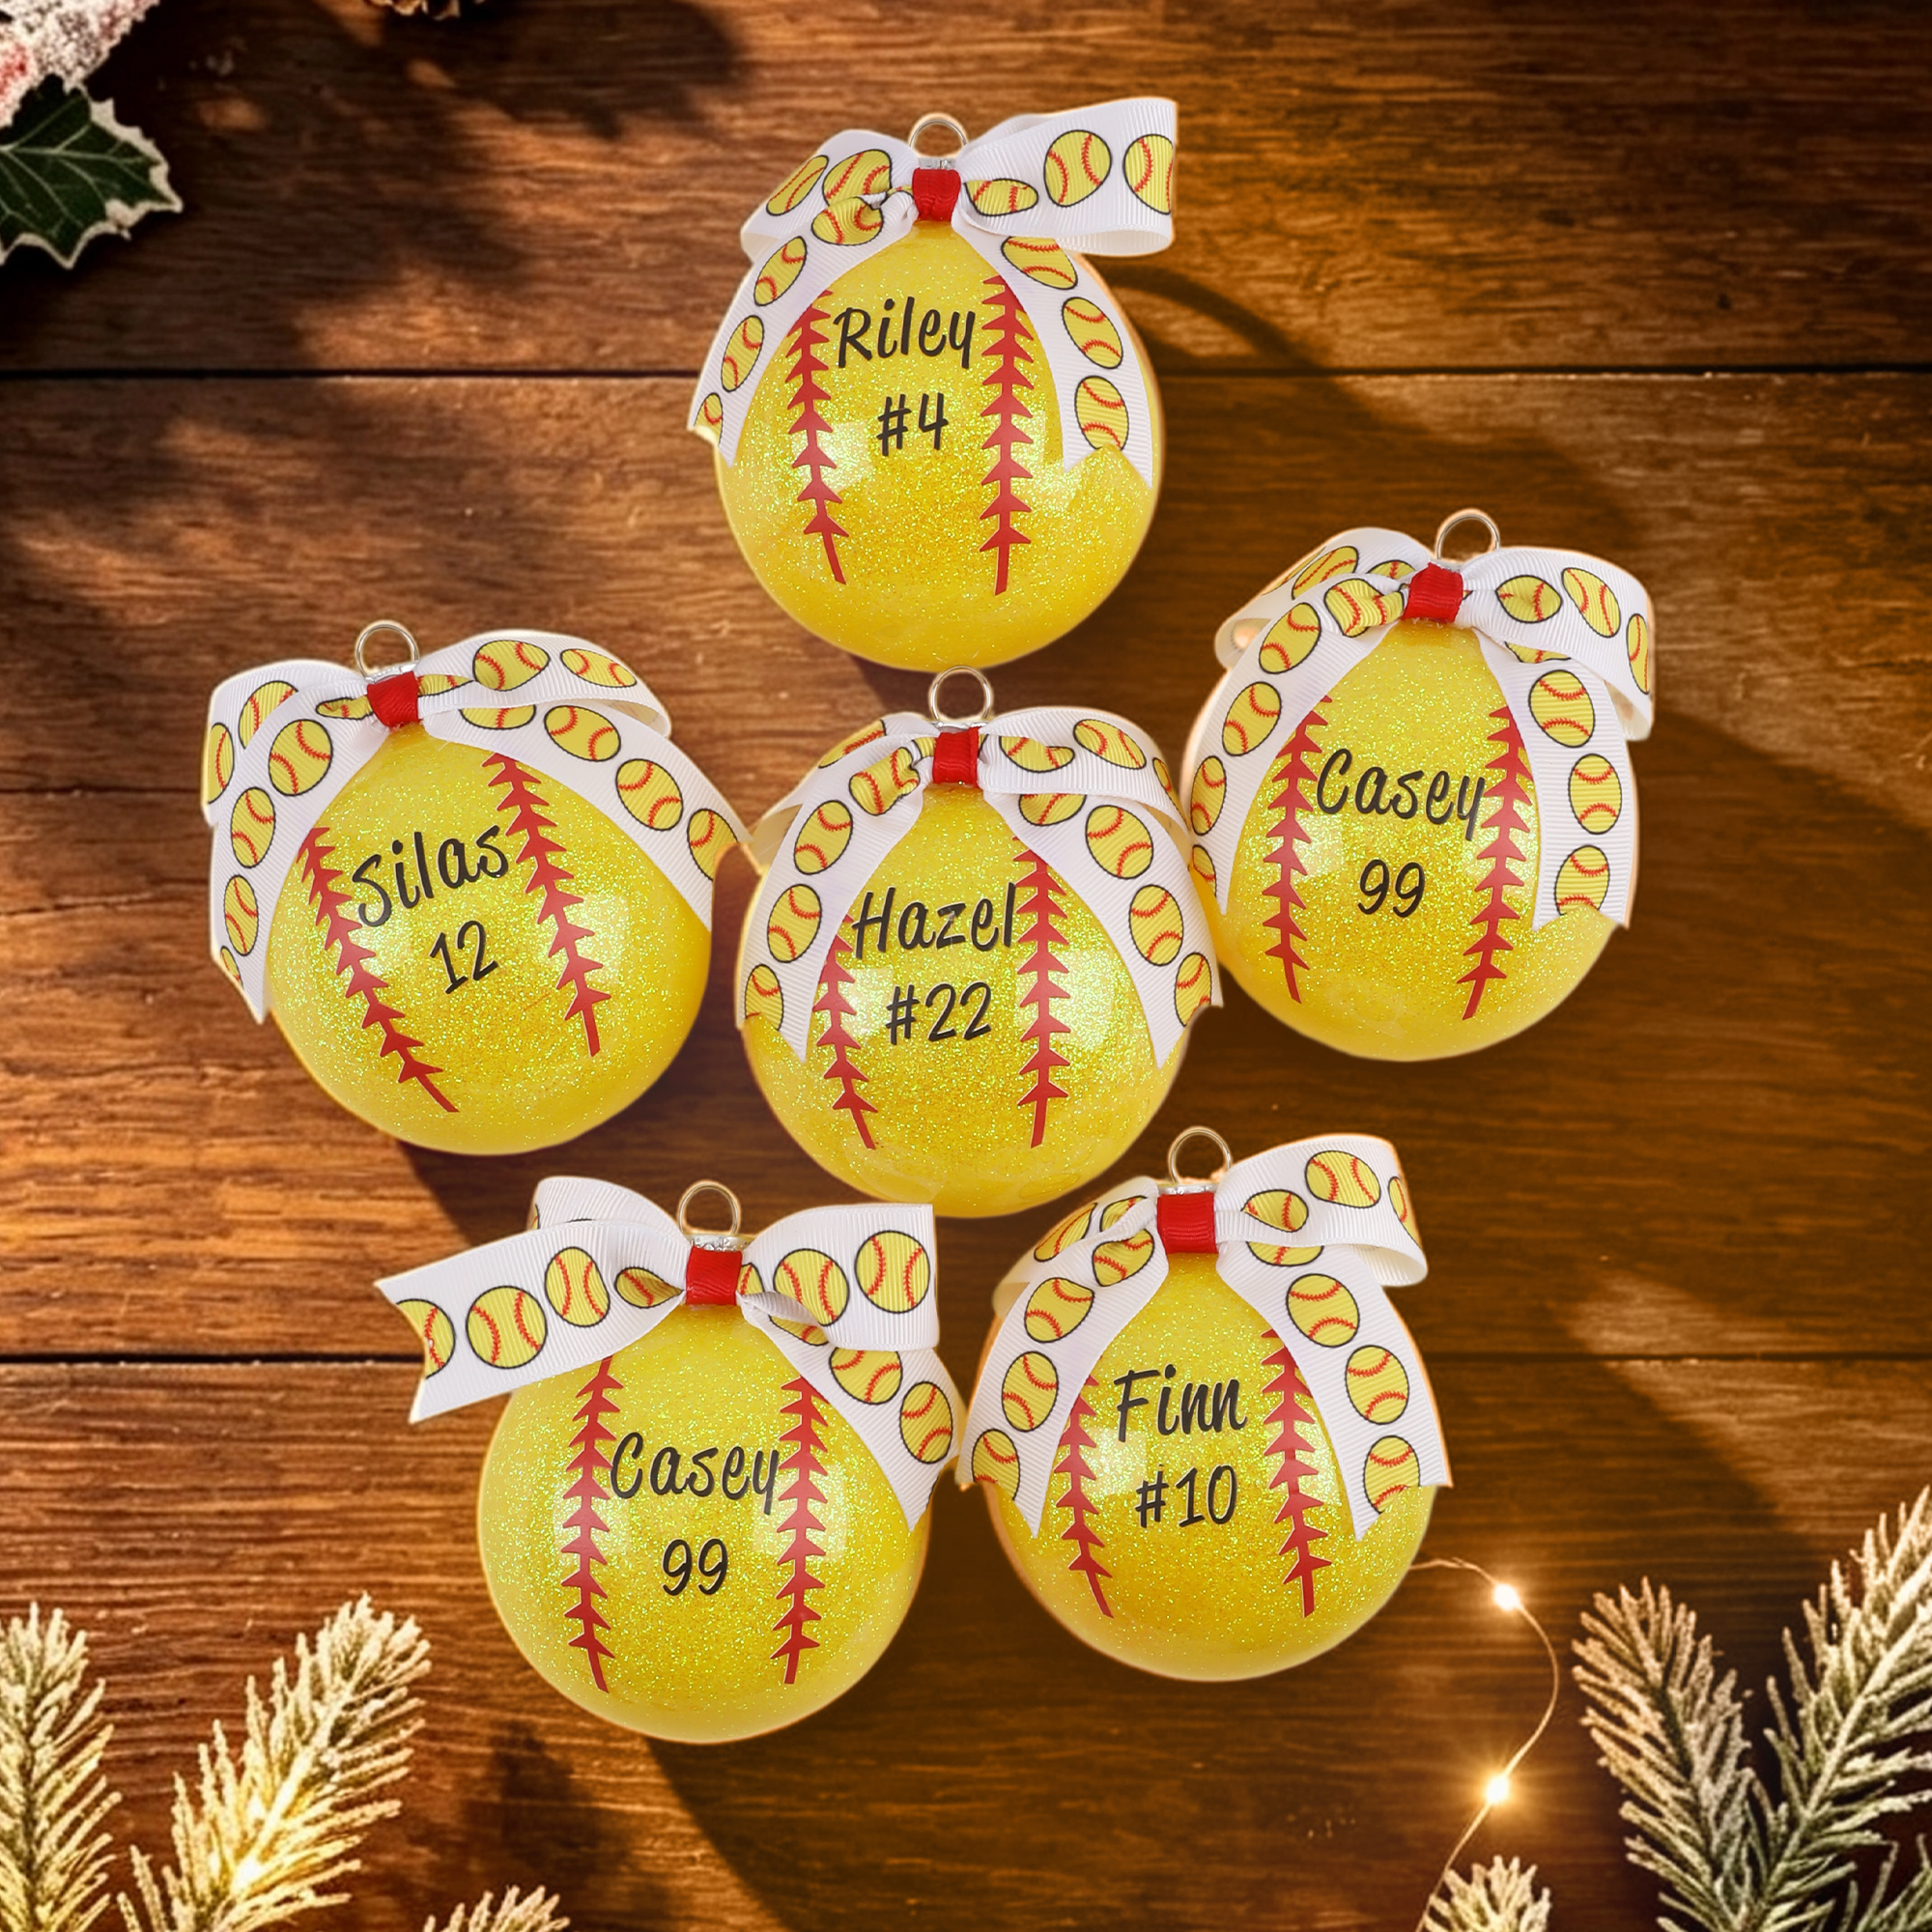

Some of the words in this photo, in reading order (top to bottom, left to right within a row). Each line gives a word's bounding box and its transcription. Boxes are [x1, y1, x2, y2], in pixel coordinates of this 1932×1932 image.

[834, 297, 975, 369] Riley
[876, 392, 949, 456] #4
[1317, 748, 1485, 840] Casey
[352, 825, 509, 927] Silas
[1358, 859, 1425, 918] 99
[852, 882, 1015, 958] Hazel
[428, 921, 499, 995] 12
[886, 981, 992, 1045] #22
[1114, 1364, 1247, 1441] Finn
[611, 1432, 779, 1516] Casey
[1135, 1464, 1237, 1528] #10
[663, 1538, 728, 1596] 99
